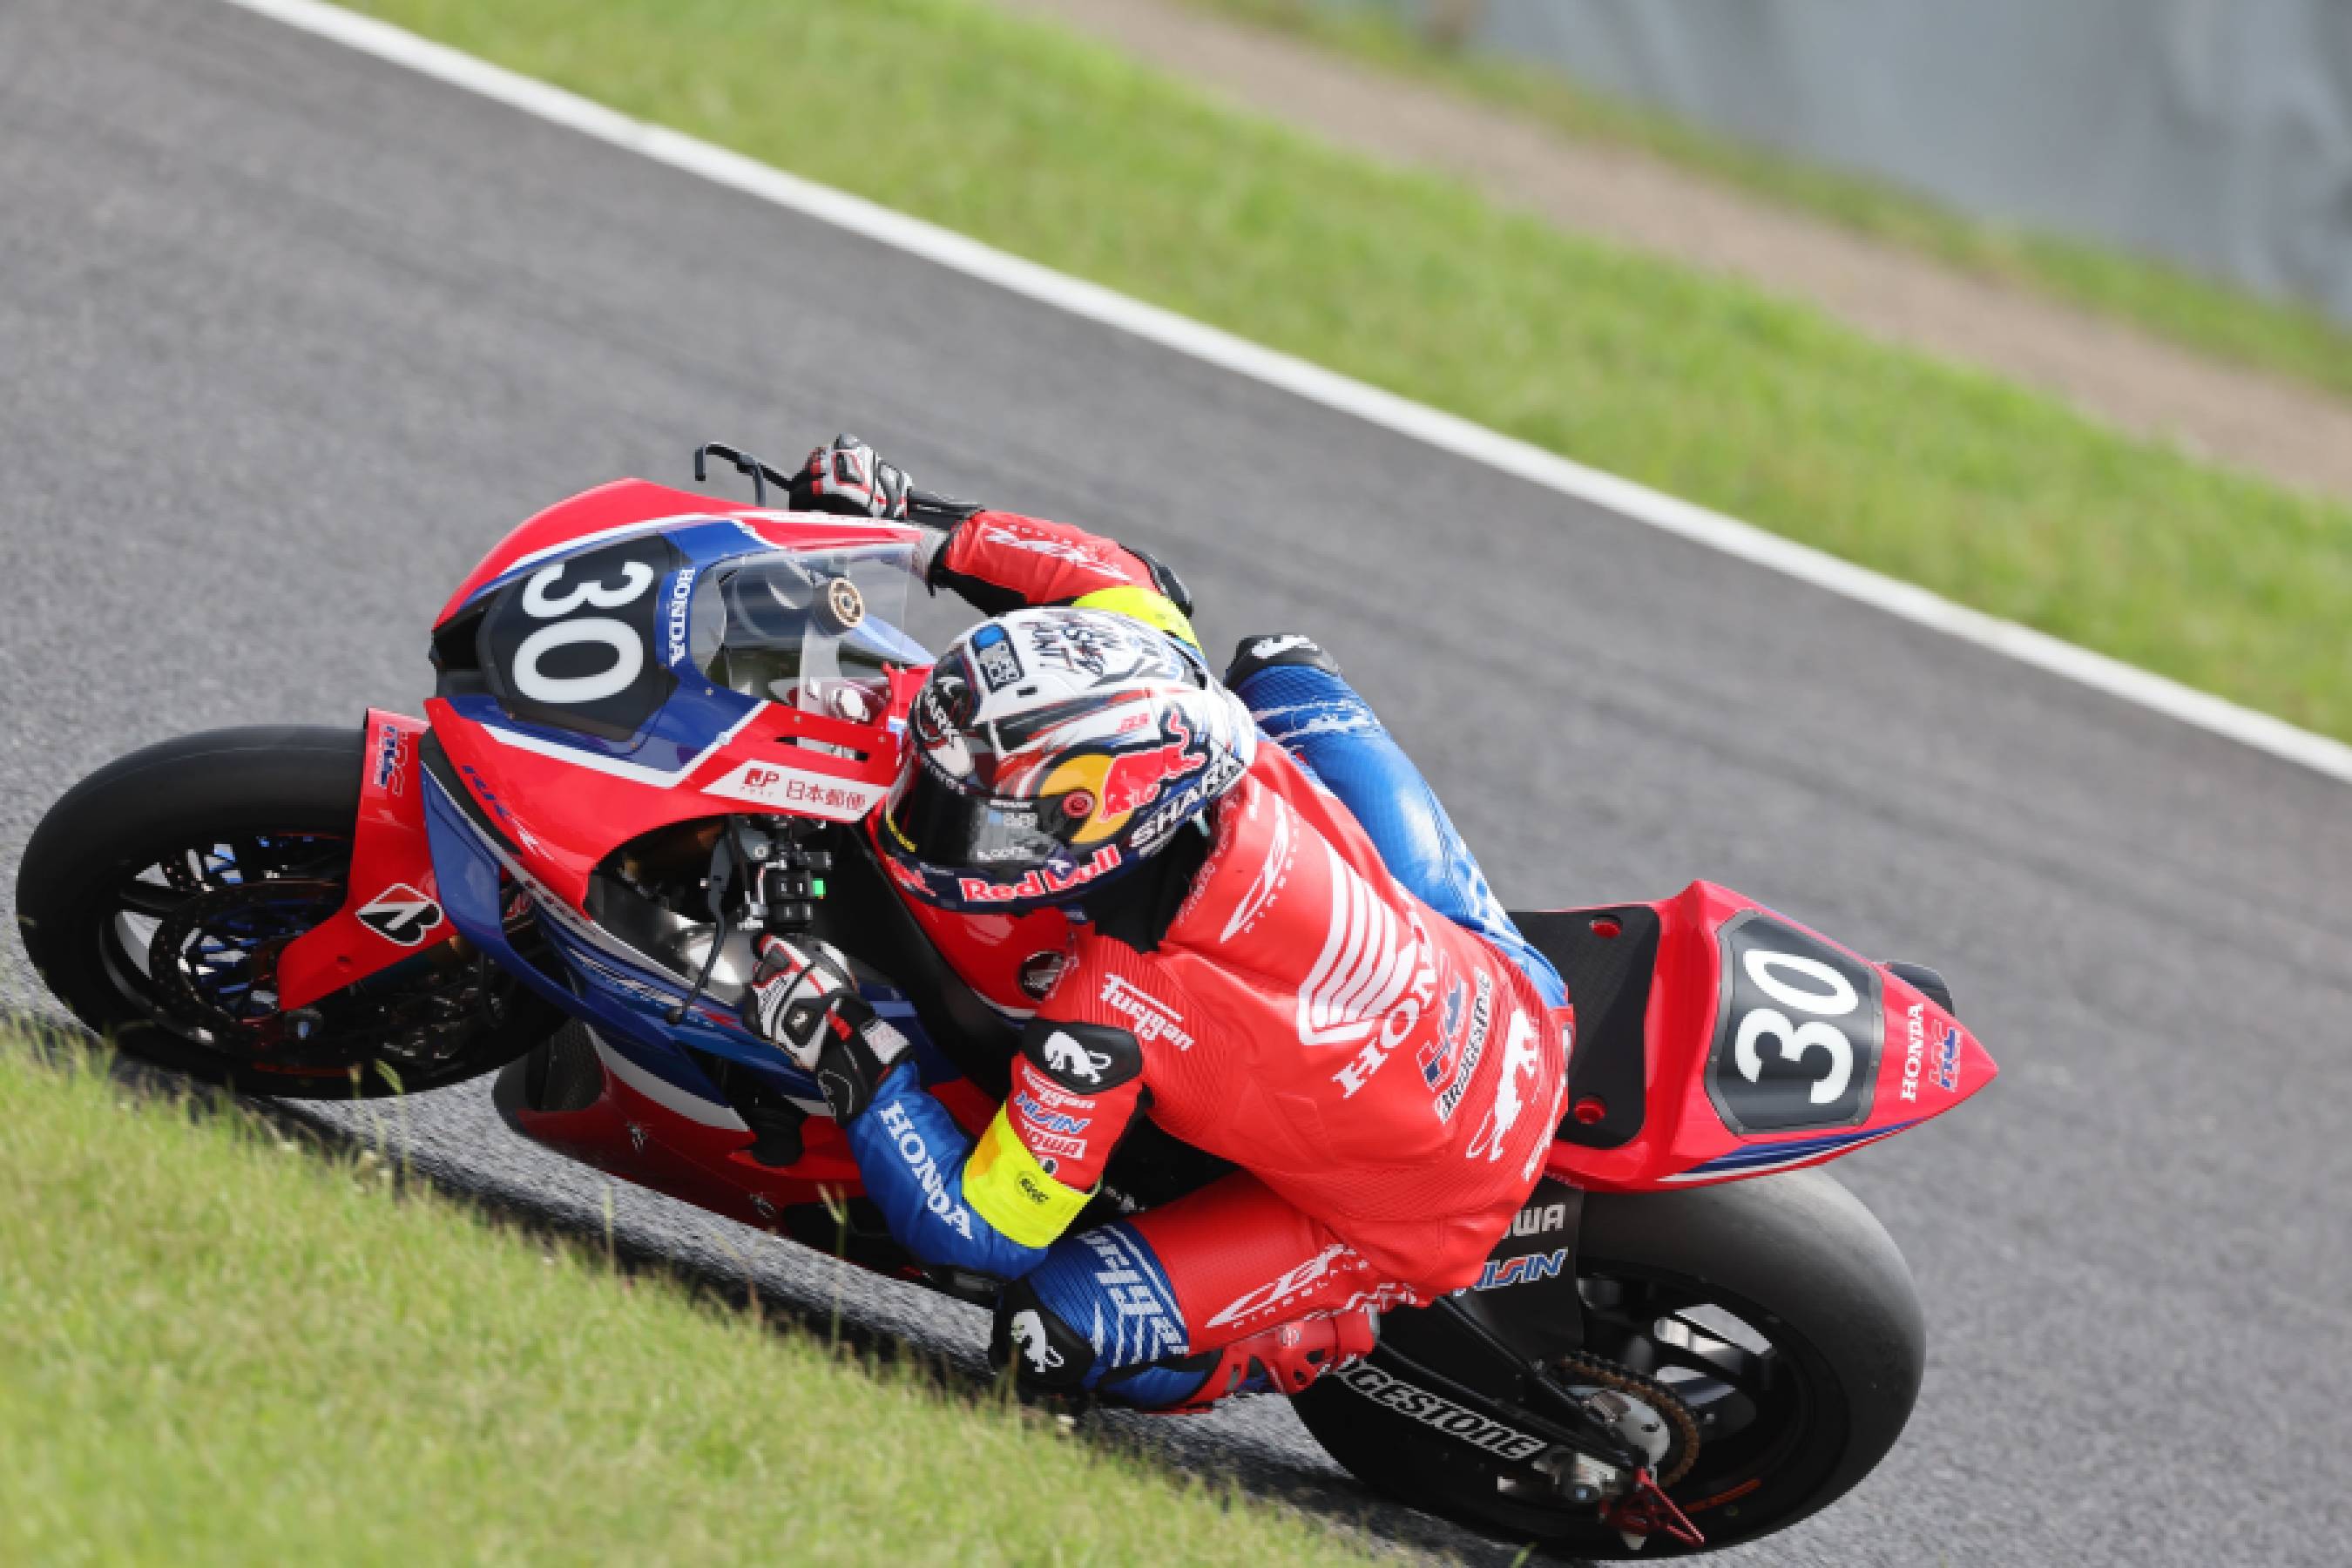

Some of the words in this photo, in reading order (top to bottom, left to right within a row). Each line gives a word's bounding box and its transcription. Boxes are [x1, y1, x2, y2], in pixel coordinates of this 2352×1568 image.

[512, 560, 653, 703] 30
[668, 565, 695, 666] HONDA
[787, 778, 866, 814] 日本郵便
[959, 870, 1043, 902] Red
[1100, 973, 1195, 1051] Furygan
[1734, 948, 1858, 1105] 30
[1901, 1003, 1924, 1103] HONDA
[1929, 1018, 1962, 1092] HRC
[878, 1099, 973, 1240] HONDA
